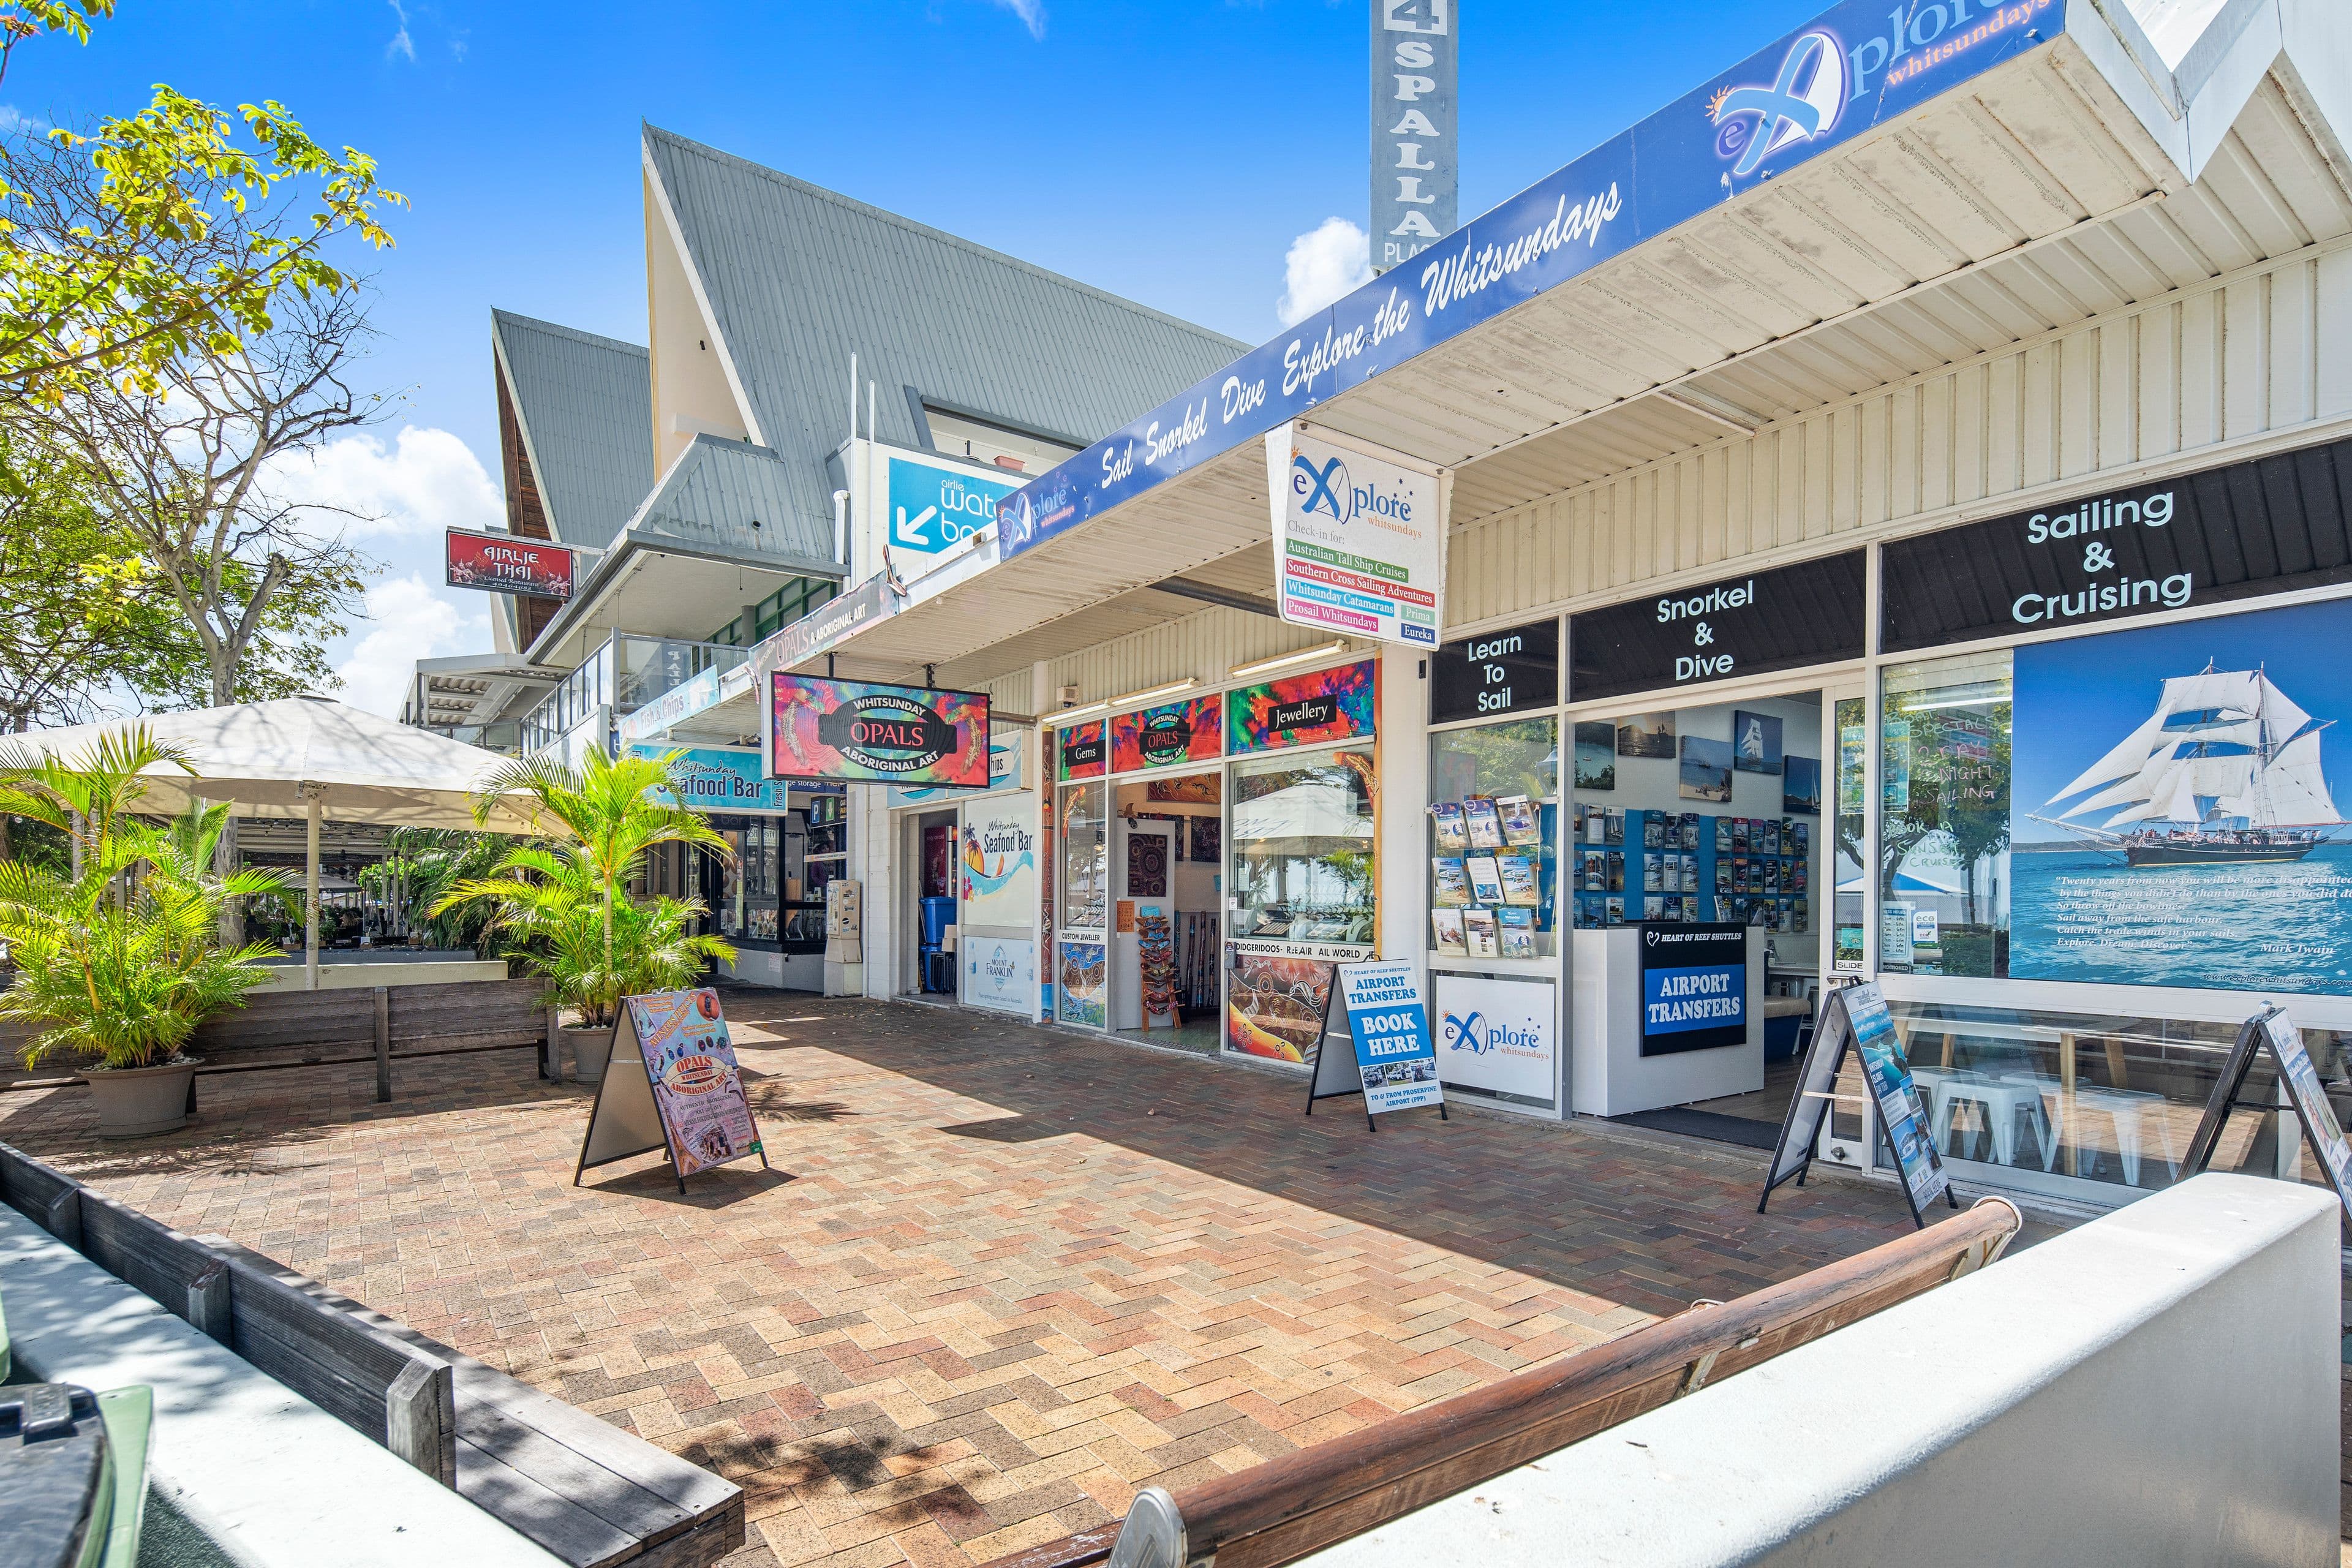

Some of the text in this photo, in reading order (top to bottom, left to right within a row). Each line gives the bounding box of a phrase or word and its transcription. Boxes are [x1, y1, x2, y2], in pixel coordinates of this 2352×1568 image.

[1389, 40, 1441, 238] SPALLA
[1101, 182, 1622, 489] Sail Snorkel Dive Explore the Whitsundays
[941, 479, 964, 491] airlie
[2028, 492, 2174, 544] Sailing
[1288, 521, 1345, 545] Check-in for:
[1367, 516, 1422, 541] whitsundays
[484, 546, 539, 564] AIRLIE
[1288, 541, 1406, 579] Australian Tall Ship Cruises
[2083, 542, 2114, 573] &
[494, 562, 531, 581] THAI
[508, 578, 538, 587] Restaurant
[1288, 560, 1433, 604] Southern Cross Sailing Adventures
[1288, 580, 1393, 613] Whitsunday Catamarans
[1657, 580, 1753, 622] Snorkel
[2012, 573, 2192, 624] Cruising
[1289, 600, 1377, 631] Prosail Whitsundays
[1406, 608, 1430, 622] Prima
[777, 625, 809, 664] OPALS
[816, 611, 853, 641] ABORIGINAL
[853, 603, 866, 622] ART
[1404, 625, 1432, 641] Eureka
[1695, 622, 1714, 646] &
[1468, 634, 1522, 662] Learn
[1483, 664, 1505, 685] To
[1676, 654, 1734, 680] Dive
[853, 698, 925, 716] WHITSUNDAY
[1477, 687, 1511, 712] Sail
[641, 709, 655, 730] Fish
[662, 694, 684, 719] Chips
[1149, 715, 1179, 728] WHITSUNDAY
[1276, 703, 1328, 729] Jewellery
[851, 722, 924, 746] OPALS
[1909, 716, 2000, 737] SPECIALS
[1148, 731, 1178, 748] OPALS
[841, 747, 940, 771] ABORIGINAL ART
[1076, 748, 1096, 760] Gems
[1145, 745, 1185, 763] ABORIGINAL ART
[668, 759, 736, 780] Whitsunday
[1940, 765, 1993, 785] NIGHT
[734, 777, 763, 797] Bar
[1926, 785, 1994, 804] SAILING
[989, 816, 1020, 835] Whitsunday
[984, 831, 1033, 854] Seafood Bar
[2126, 876, 2152, 886] from
[2179, 878, 2200, 886] you
[2060, 889, 2071, 899] by
[2091, 889, 2122, 899] things
[2124, 891, 2143, 899] you
[2179, 889, 2193, 897] do
[2225, 889, 2237, 899] by
[2241, 889, 2258, 897] the
[2291, 891, 2313, 900] you
[2315, 888, 2338, 897] did
[2102, 902, 2117, 911] off
[2118, 902, 2134, 910] the
[2136, 902, 2185, 910] bowlines.
[2057, 913, 2076, 922] Sail
[2106, 914, 2132, 924] from
[2153, 914, 2173, 924] safe
[2176, 914, 2223, 924] harbour.
[2057, 925, 2238, 938] Catch the trade winds in your sails.
[2057, 938, 2137, 948] Explore. Dream.
[2260, 944, 2334, 954] Mark Twain
[986, 962, 1013, 978] FRANKLIN
[1355, 976, 1406, 990] AIRPORT
[1660, 974, 1730, 997] AIRPORT
[1349, 989, 1416, 1003] TRANSFERS
[1649, 997, 1740, 1023] TRANSFERS
[1361, 1013, 1417, 1034] BOOK
[1368, 1035, 1420, 1056] HERE
[1501, 1047, 1549, 1061] whitsundays
[676, 1055, 713, 1072] OPALS
[670, 1071, 727, 1095] ABORIGINAL ART
[681, 1069, 713, 1081] WHITSUNDAY
[1385, 1095, 1426, 1107] AIRPORT (PPP)
[1403, 1086, 1437, 1096] PROSERPINE
